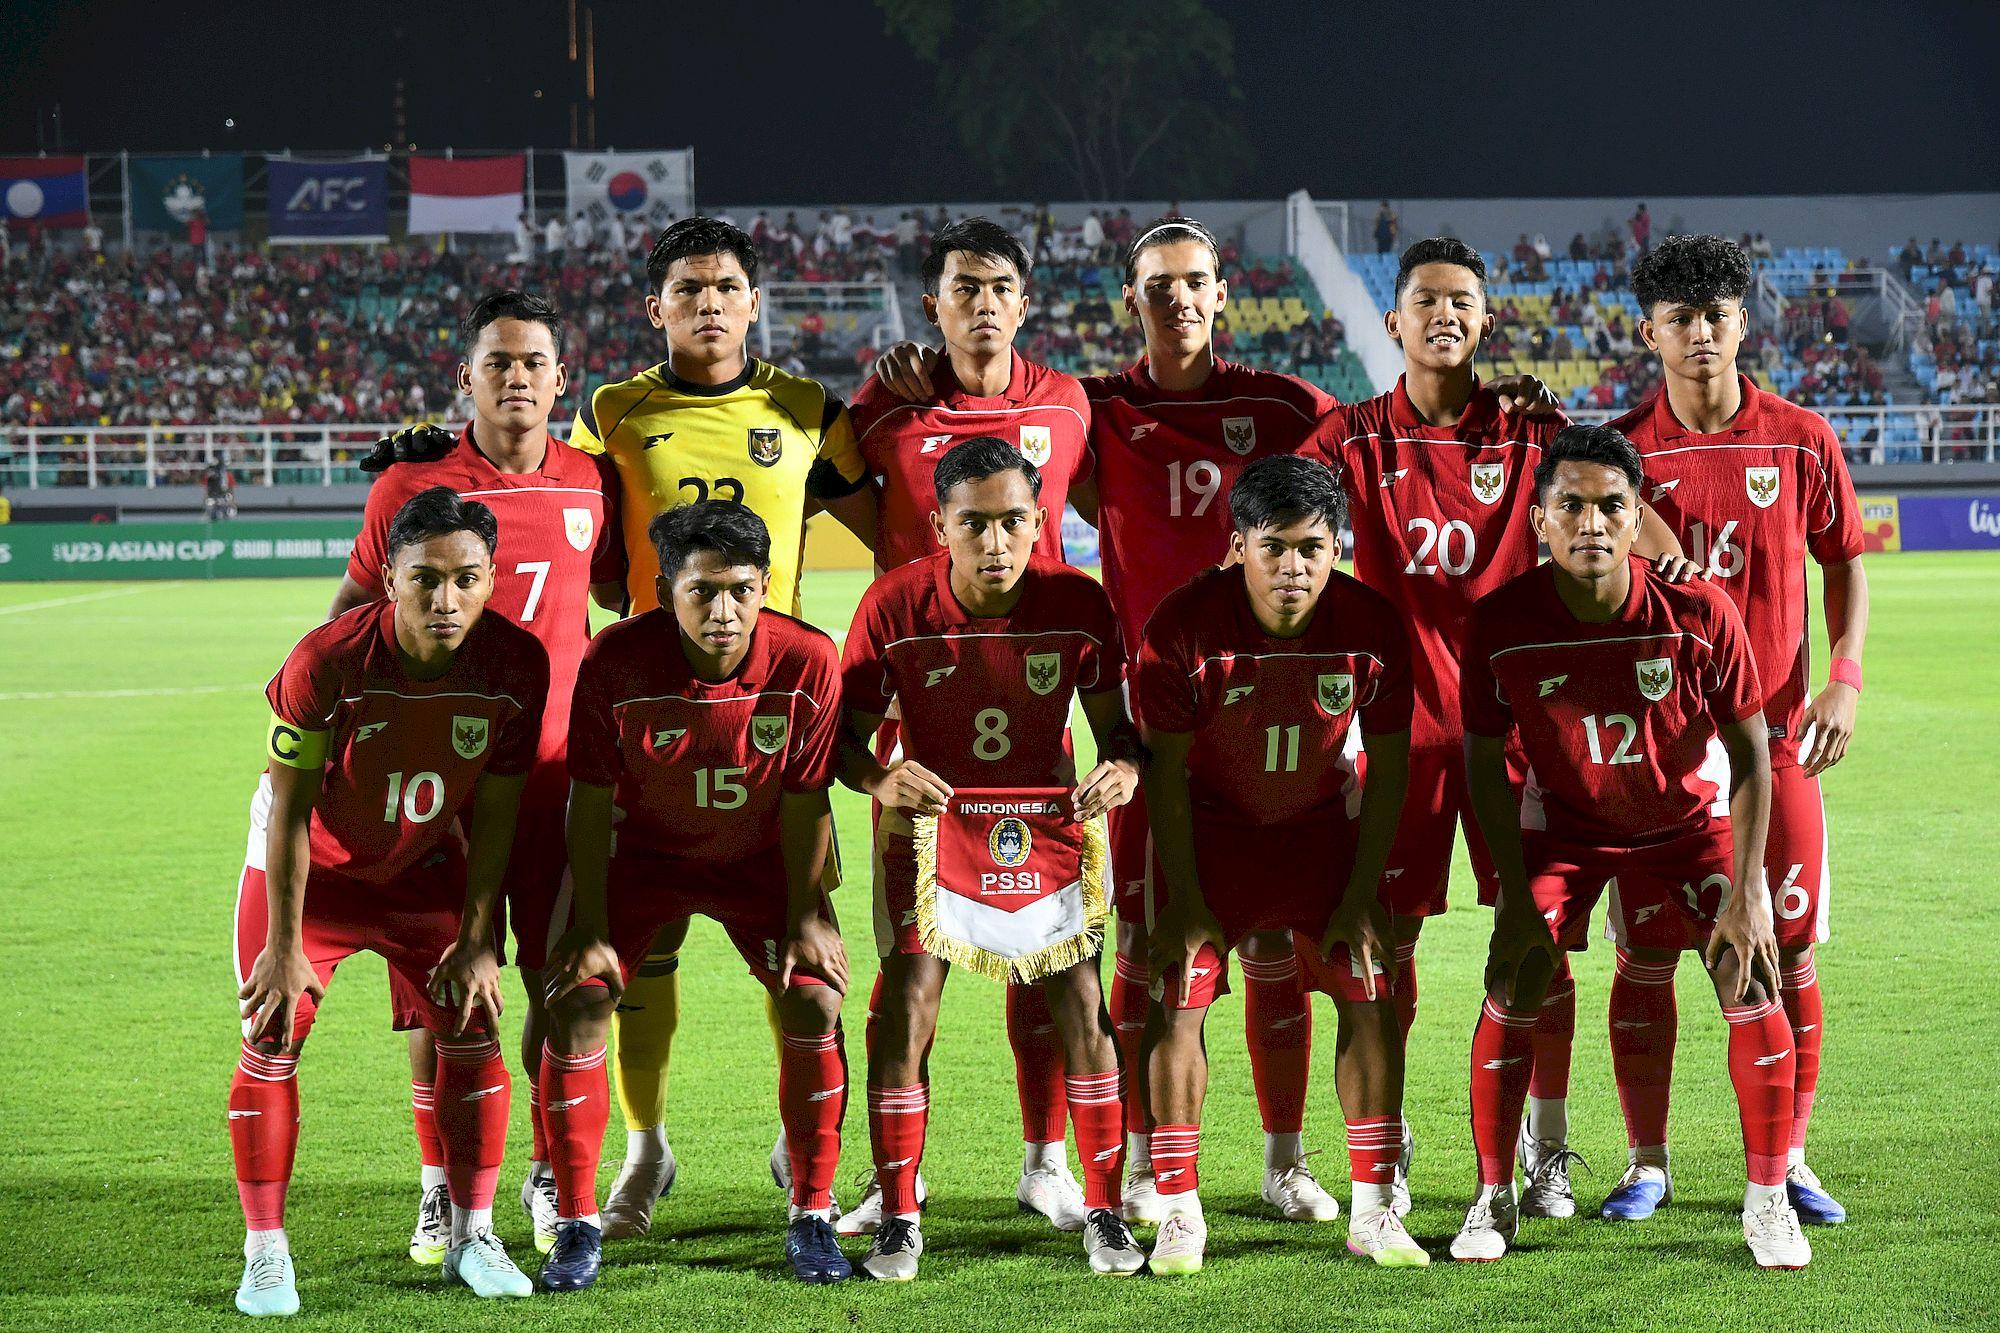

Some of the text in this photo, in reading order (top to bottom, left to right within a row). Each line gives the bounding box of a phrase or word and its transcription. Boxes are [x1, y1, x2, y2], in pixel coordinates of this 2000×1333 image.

[286, 179, 367, 211] AFC
[1166, 460, 1222, 517] 19
[61, 541, 104, 562] U23
[107, 540, 175, 562] ASIAN
[177, 539, 225, 561] CUP
[1404, 517, 1476, 576] 20
[1689, 520, 1745, 578] 16
[515, 561, 551, 622] 7
[272, 726, 303, 760] C
[973, 708, 1011, 761] 8
[1265, 725, 1300, 772] 11
[1581, 713, 1644, 765] 12
[384, 771, 446, 824] 10
[693, 766, 748, 810] 15
[960, 802, 1061, 815] INDONESIA
[980, 871, 1041, 891] PSSI
[1774, 863, 1809, 920] 6
